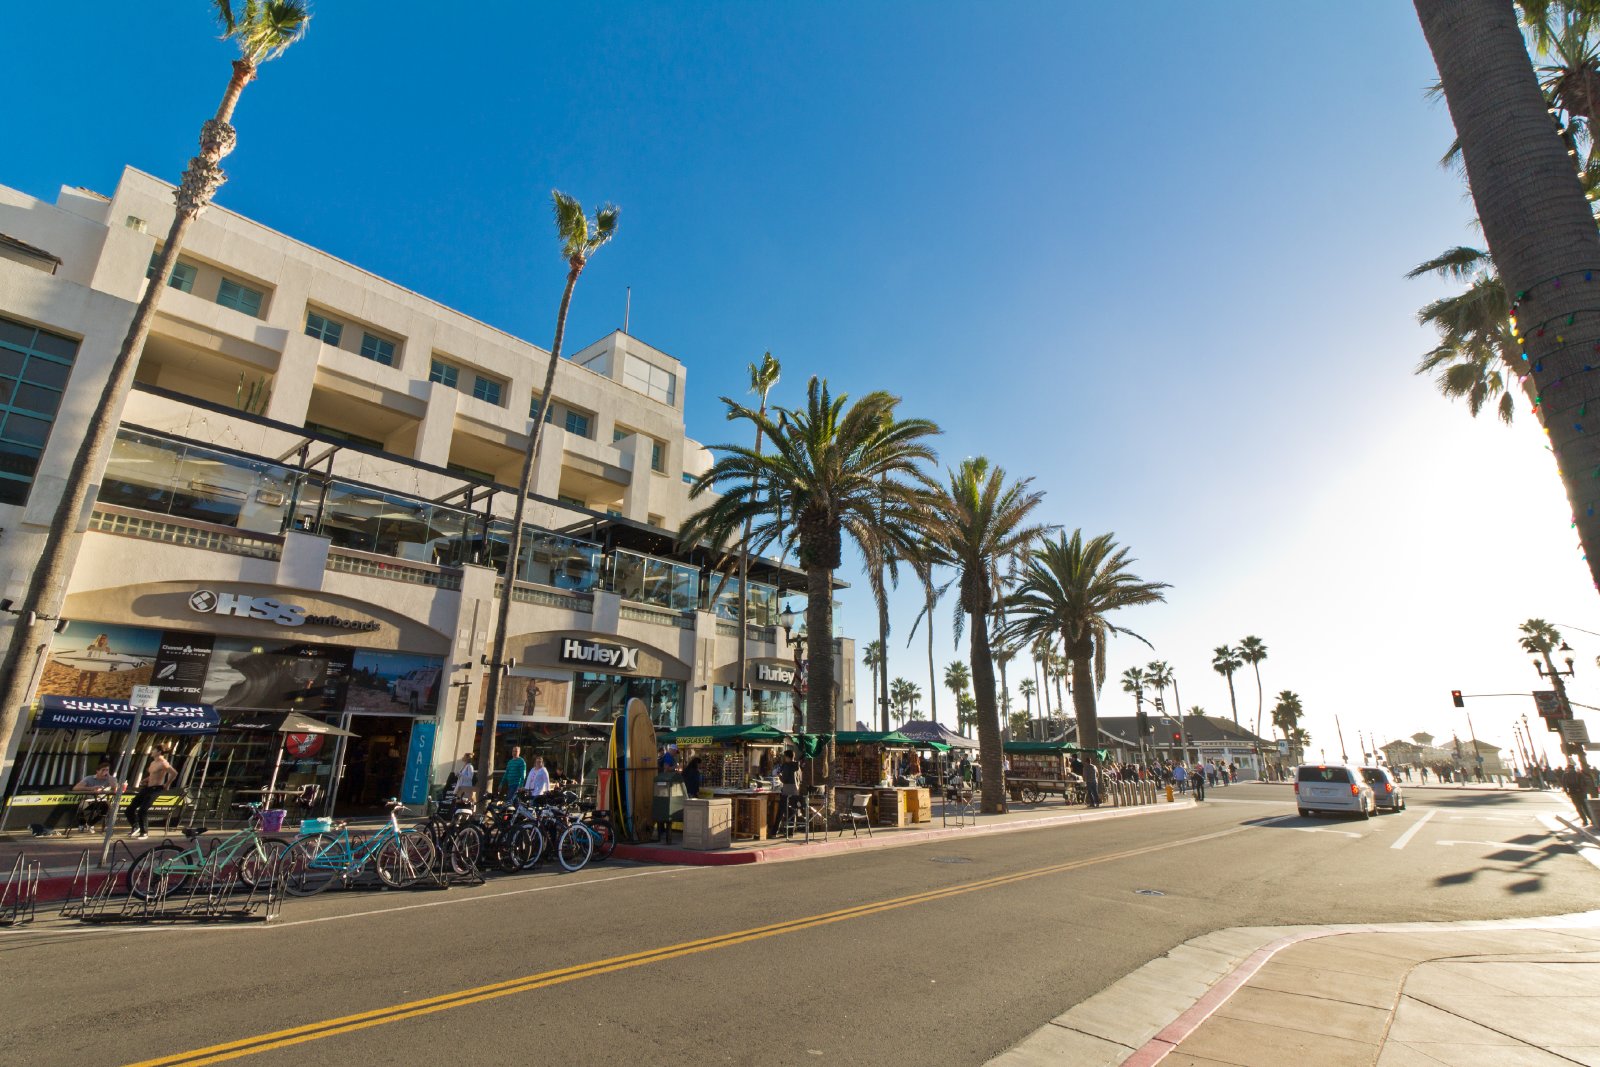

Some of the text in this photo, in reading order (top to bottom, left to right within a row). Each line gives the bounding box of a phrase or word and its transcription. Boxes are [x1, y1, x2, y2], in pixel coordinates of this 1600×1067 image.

[215, 592, 381, 632] HSS surfboards
[563, 639, 621, 666] Hurley
[758, 664, 795, 685] Hurley
[52, 714, 131, 726] HUNTINGTON
[139, 719, 211, 729] URF SPORT
[411, 735, 426, 799] SALE
